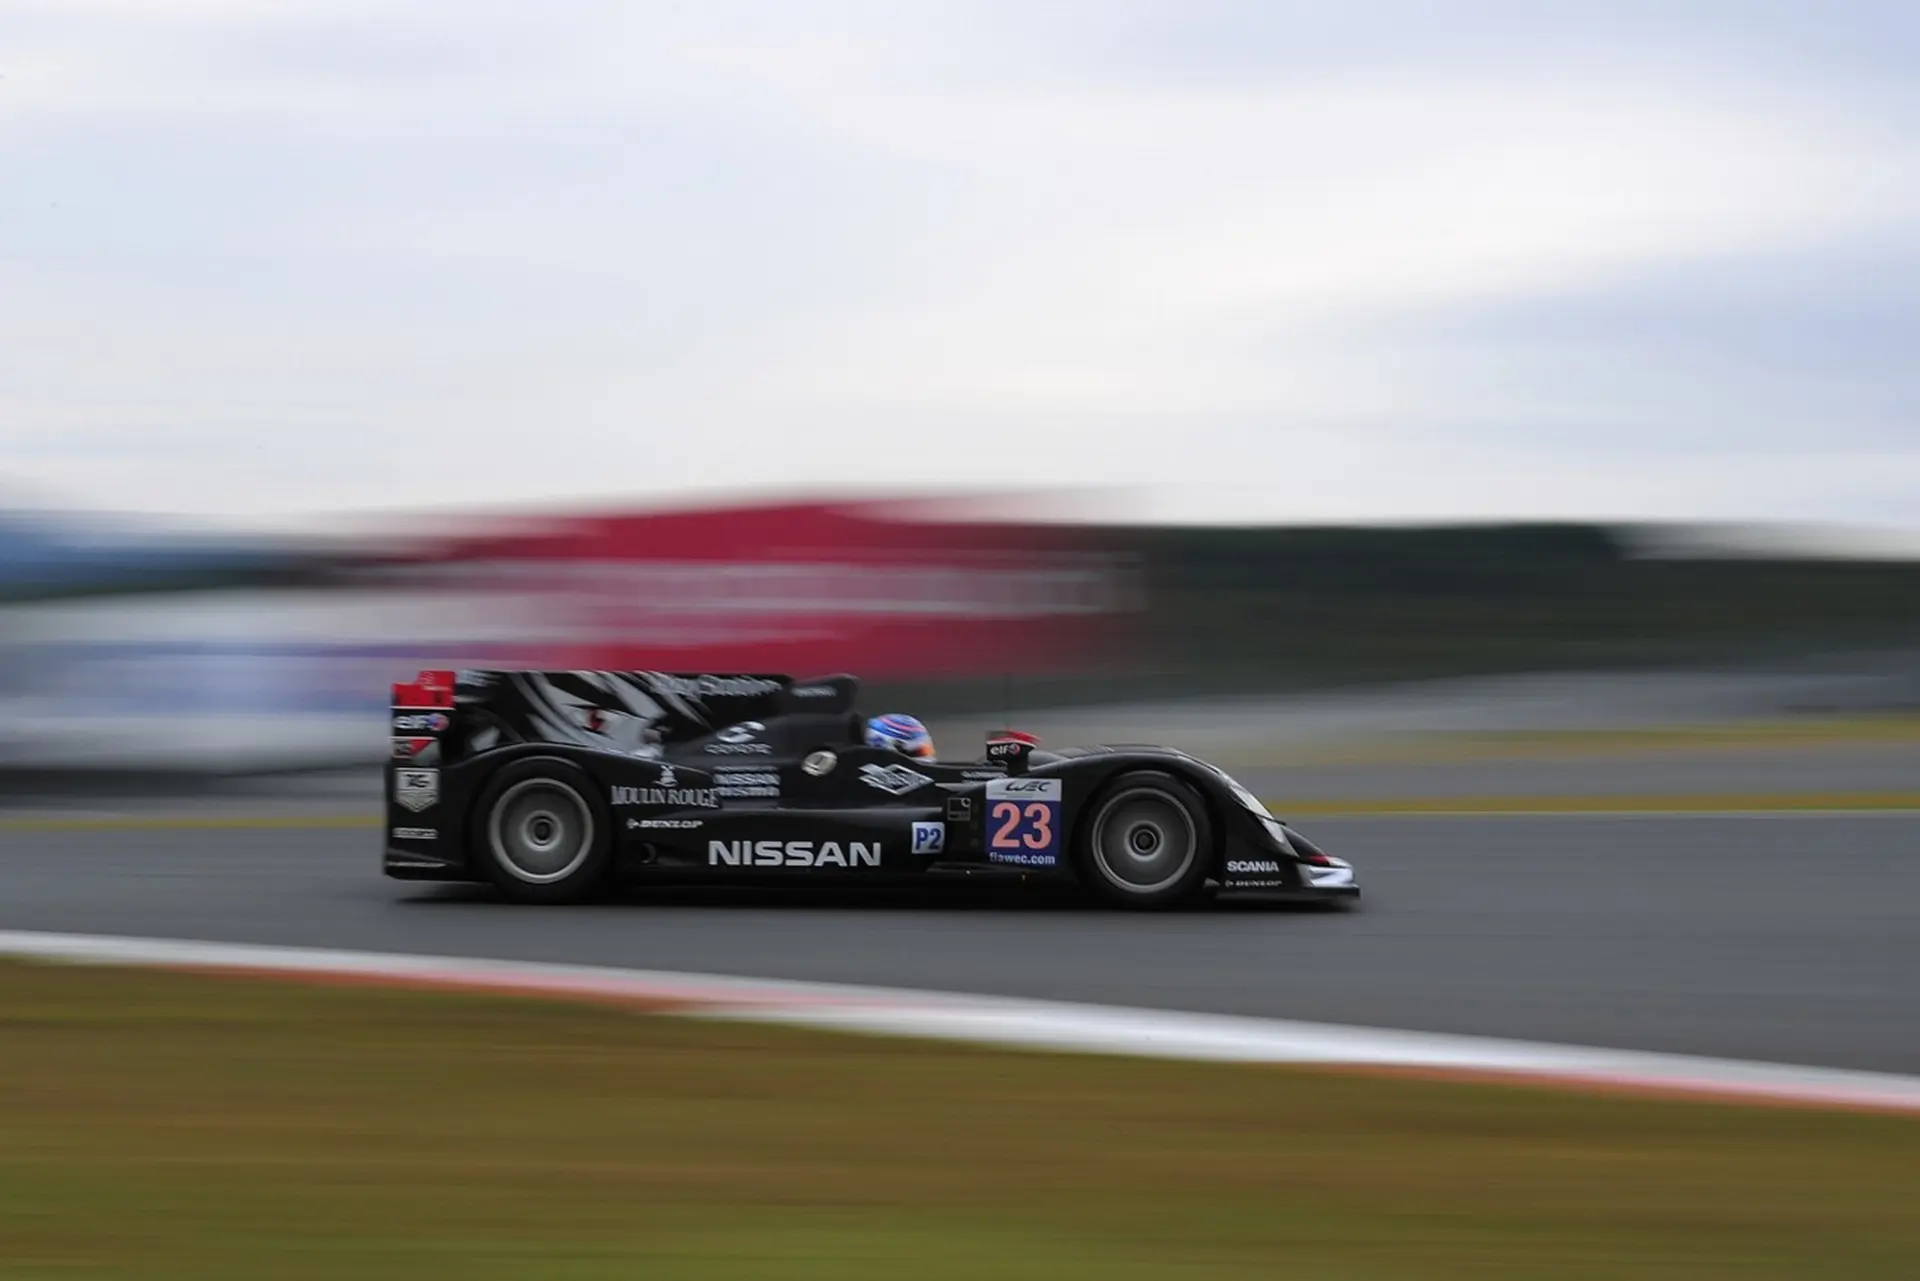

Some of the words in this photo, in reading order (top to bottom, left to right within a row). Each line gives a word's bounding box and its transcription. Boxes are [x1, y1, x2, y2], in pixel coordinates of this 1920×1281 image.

[990, 745, 1009, 755] elf
[1005, 781, 1051, 792] WEC
[611, 786, 666, 805] MOULIN
[668, 788, 719, 808] ROUGE
[639, 819, 703, 828] DUNLOP
[992, 802, 1052, 849] 23
[916, 827, 942, 850] P2
[709, 840, 881, 867] NISSAN
[989, 852, 1056, 865] fiawec.com
[1227, 860, 1280, 873] SCANIA
[1235, 879, 1283, 888] DUNLOP
